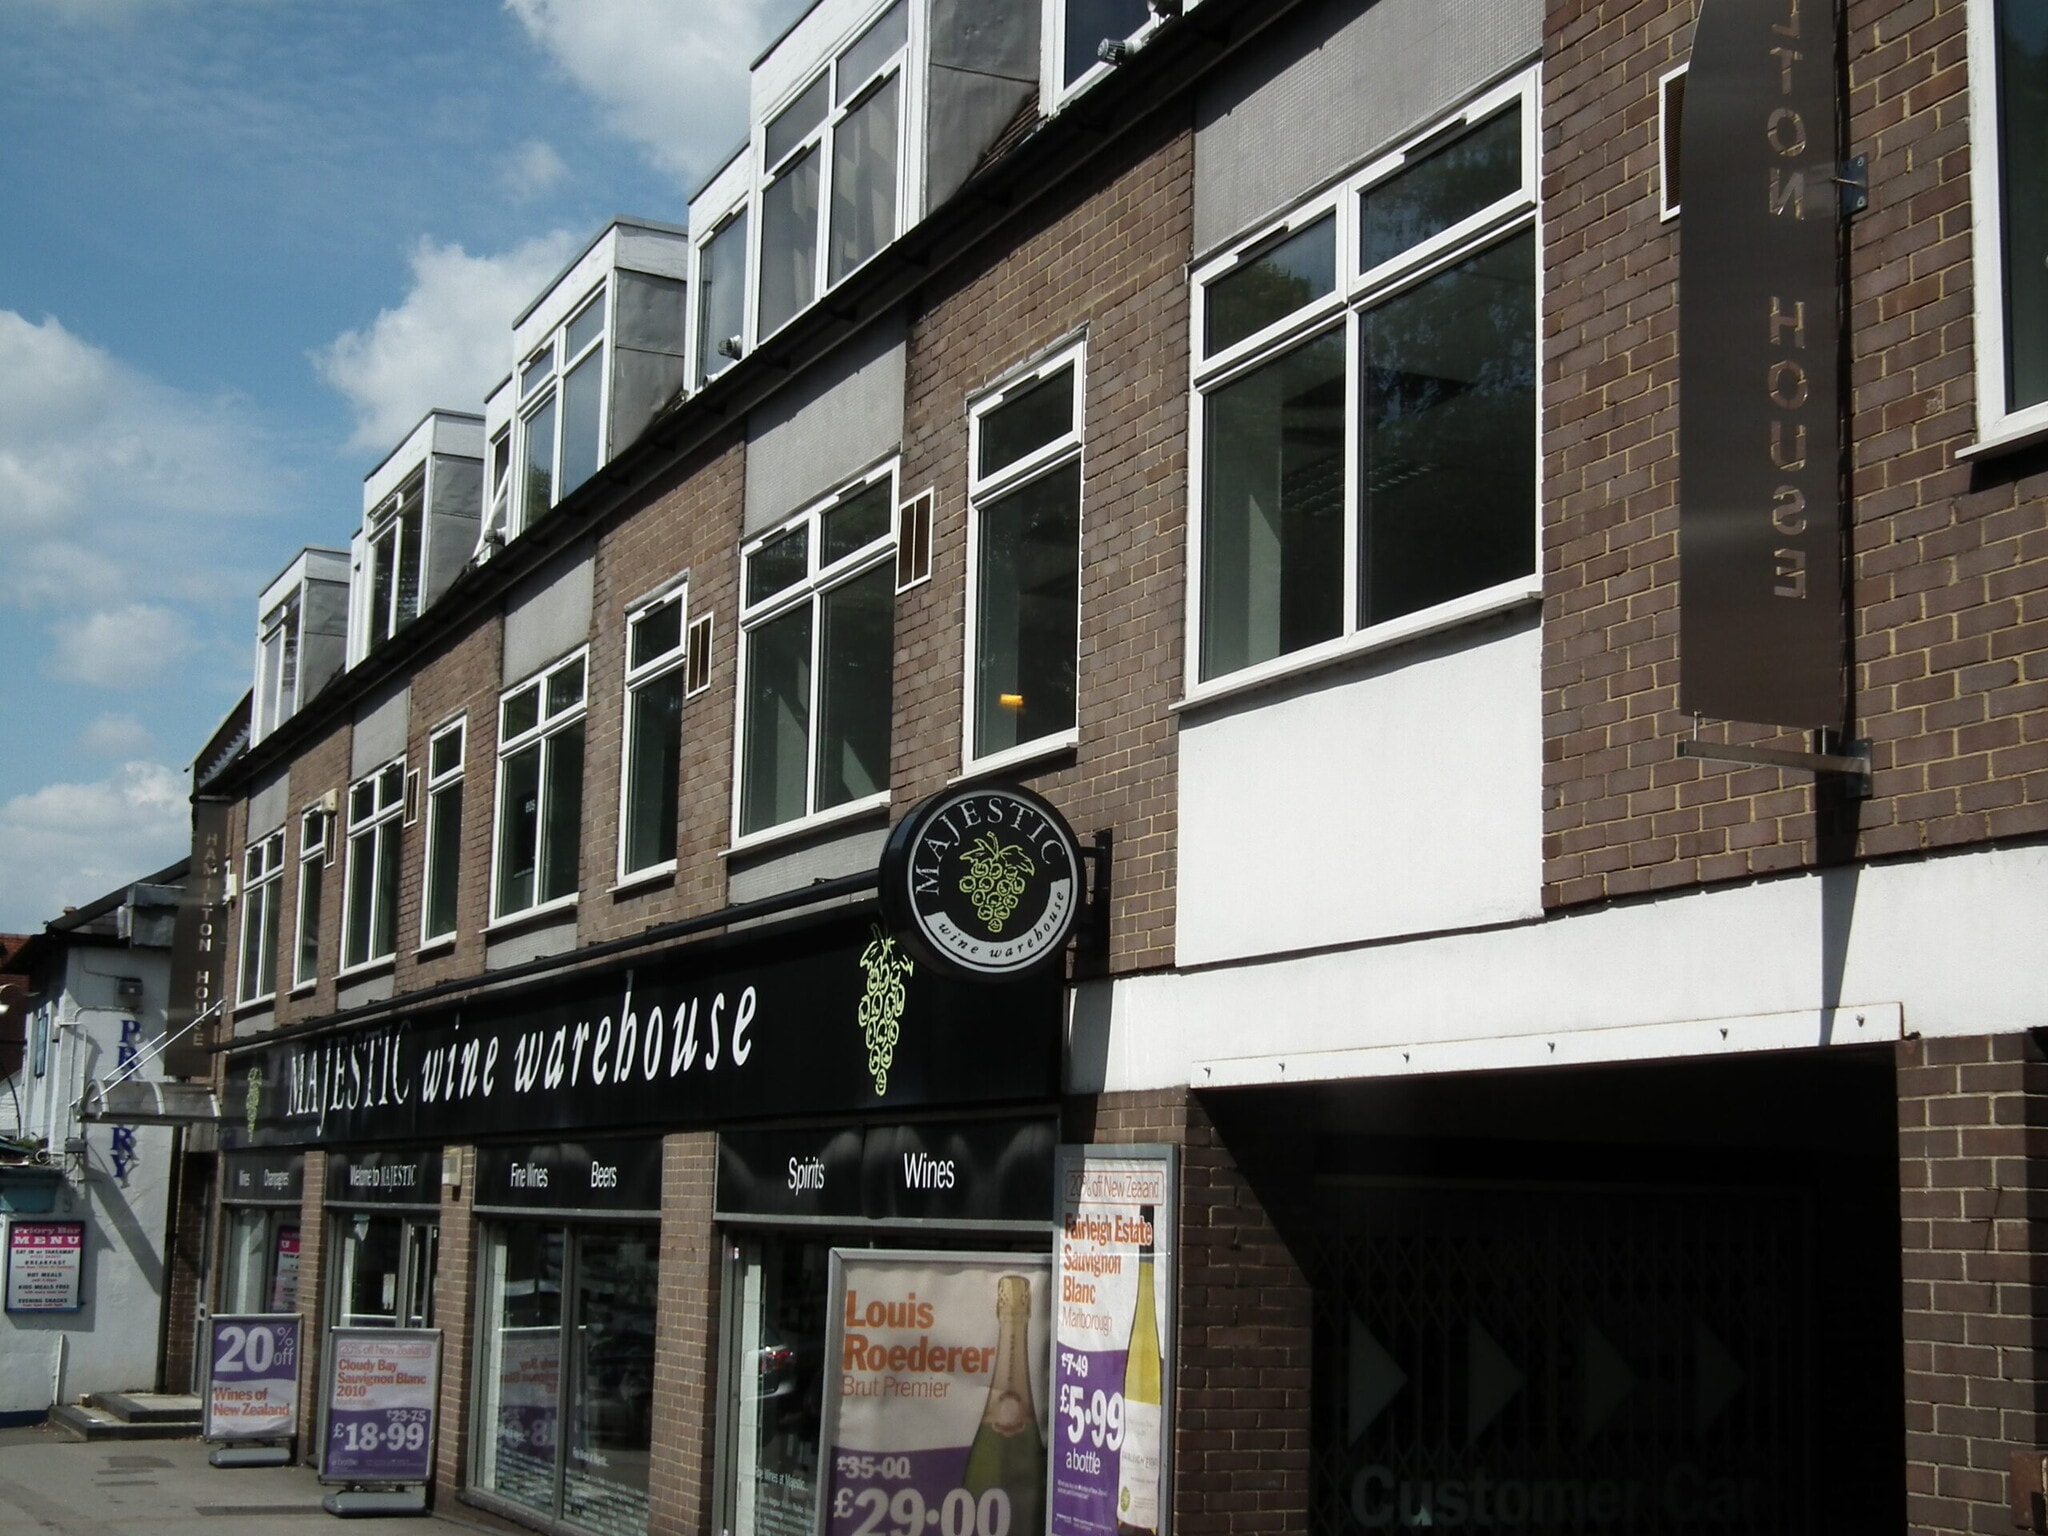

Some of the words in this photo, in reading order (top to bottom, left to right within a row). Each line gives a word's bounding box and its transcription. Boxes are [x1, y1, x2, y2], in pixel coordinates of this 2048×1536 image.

[914, 797, 1066, 895] MAJESTIC
[938, 922, 979, 954] wine
[989, 891, 1064, 957] warehouse
[286, 1019, 412, 1136] MAJESTIC
[421, 1012, 499, 1103] wine
[514, 970, 757, 1093] warehouse
[350, 1164, 372, 1186] Welcome
[380, 1164, 417, 1192] MAJESTIC
[510, 1162, 527, 1187] Fine
[527, 1163, 548, 1187] Wines
[590, 1161, 617, 1188] Beers
[787, 1156, 825, 1196] Spirits
[903, 1152, 955, 1189] Wines
[1104, 1177, 1124, 1197] New
[1125, 1176, 1160, 1199] Zealand
[14, 1235, 80, 1244] MENU
[1064, 1213, 1112, 1246] Fairleigh
[1114, 1215, 1153, 1246] Estate
[1064, 1244, 1121, 1278] Sauvignon
[1063, 1275, 1096, 1304] Blanc
[846, 1290, 935, 1329] Louis
[1062, 1306, 1113, 1337] Marlborough
[273, 1347, 295, 1366] off
[376, 1344, 394, 1355] New
[396, 1344, 430, 1356] Zealand
[843, 1333, 995, 1374] Roederer
[338, 1358, 375, 1373] Cloudy
[377, 1359, 398, 1373] Bay
[338, 1372, 394, 1386] Sauvignon
[396, 1372, 426, 1385] Blanc
[214, 1387, 253, 1401] Wines
[255, 1387, 269, 1401] of
[336, 1385, 366, 1397] 2010
[841, 1374, 879, 1397] Brut
[883, 1375, 950, 1398] Premier
[214, 1403, 240, 1416] New
[241, 1402, 290, 1417] Zealand
[1073, 1447, 1101, 1475] bottle
[1350, 1463, 1653, 1530] Customer
